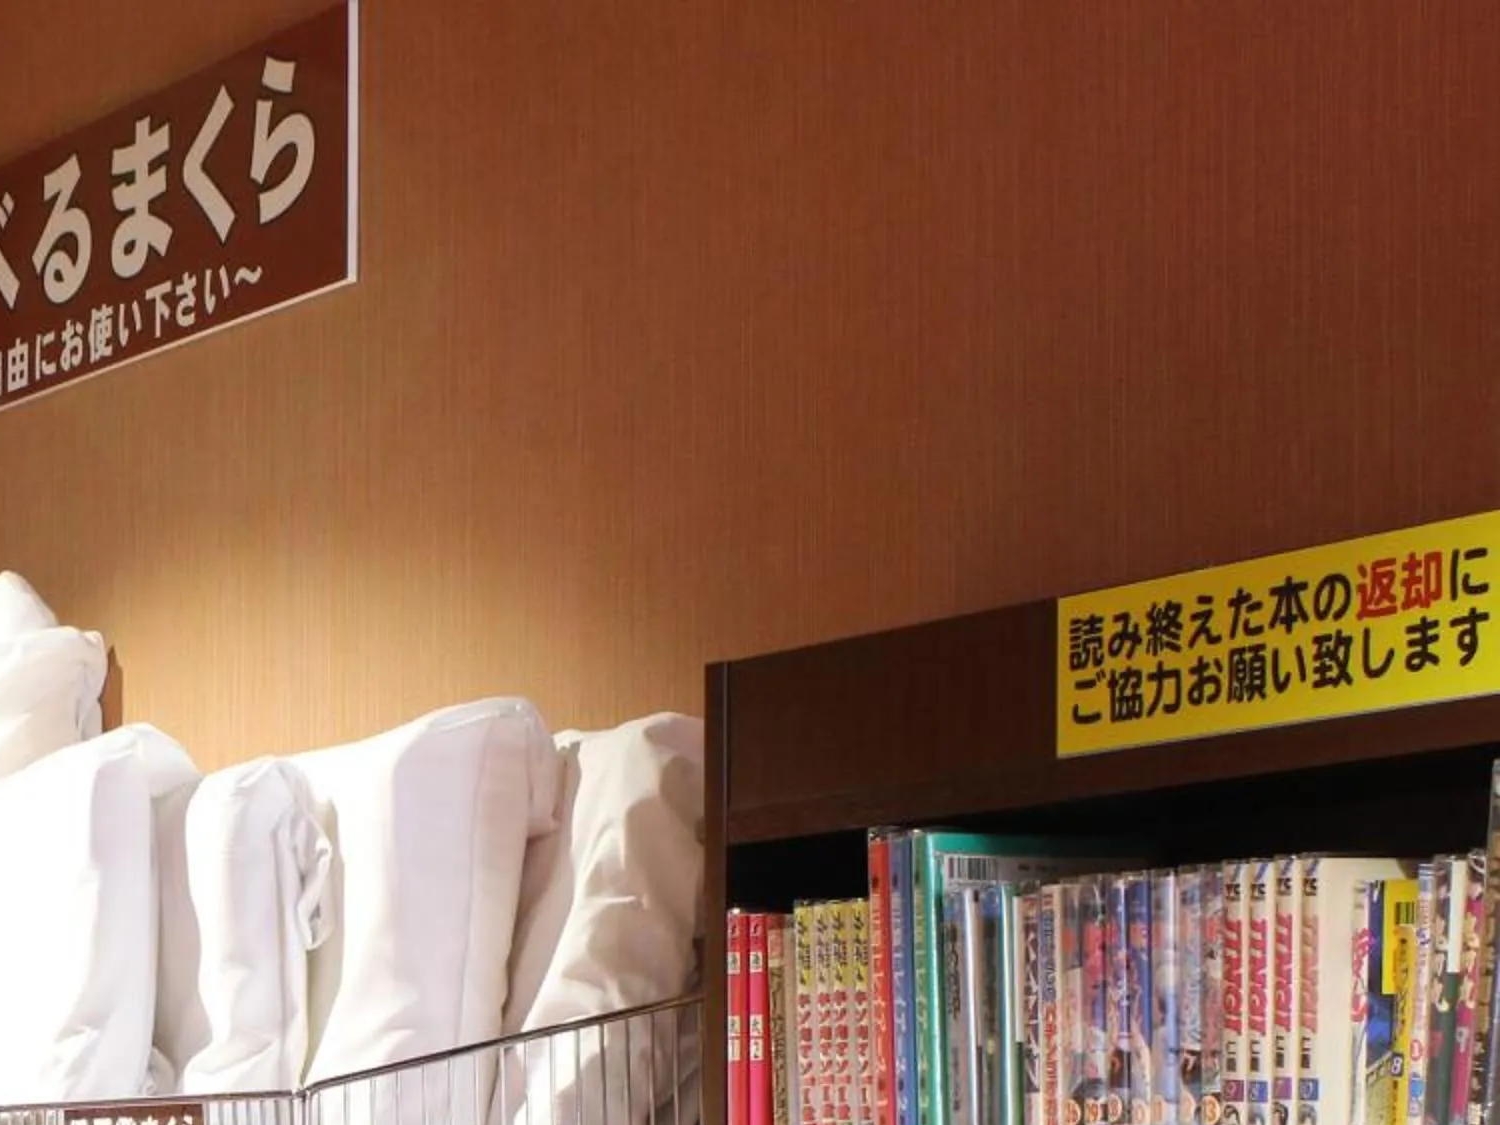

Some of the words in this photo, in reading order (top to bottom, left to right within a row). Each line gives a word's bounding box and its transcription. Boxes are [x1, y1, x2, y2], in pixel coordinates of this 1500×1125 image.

[1069, 547, 1489, 672] 読み終えた本の返却に
[1072, 606, 1491, 725] ご協力お願い致します
